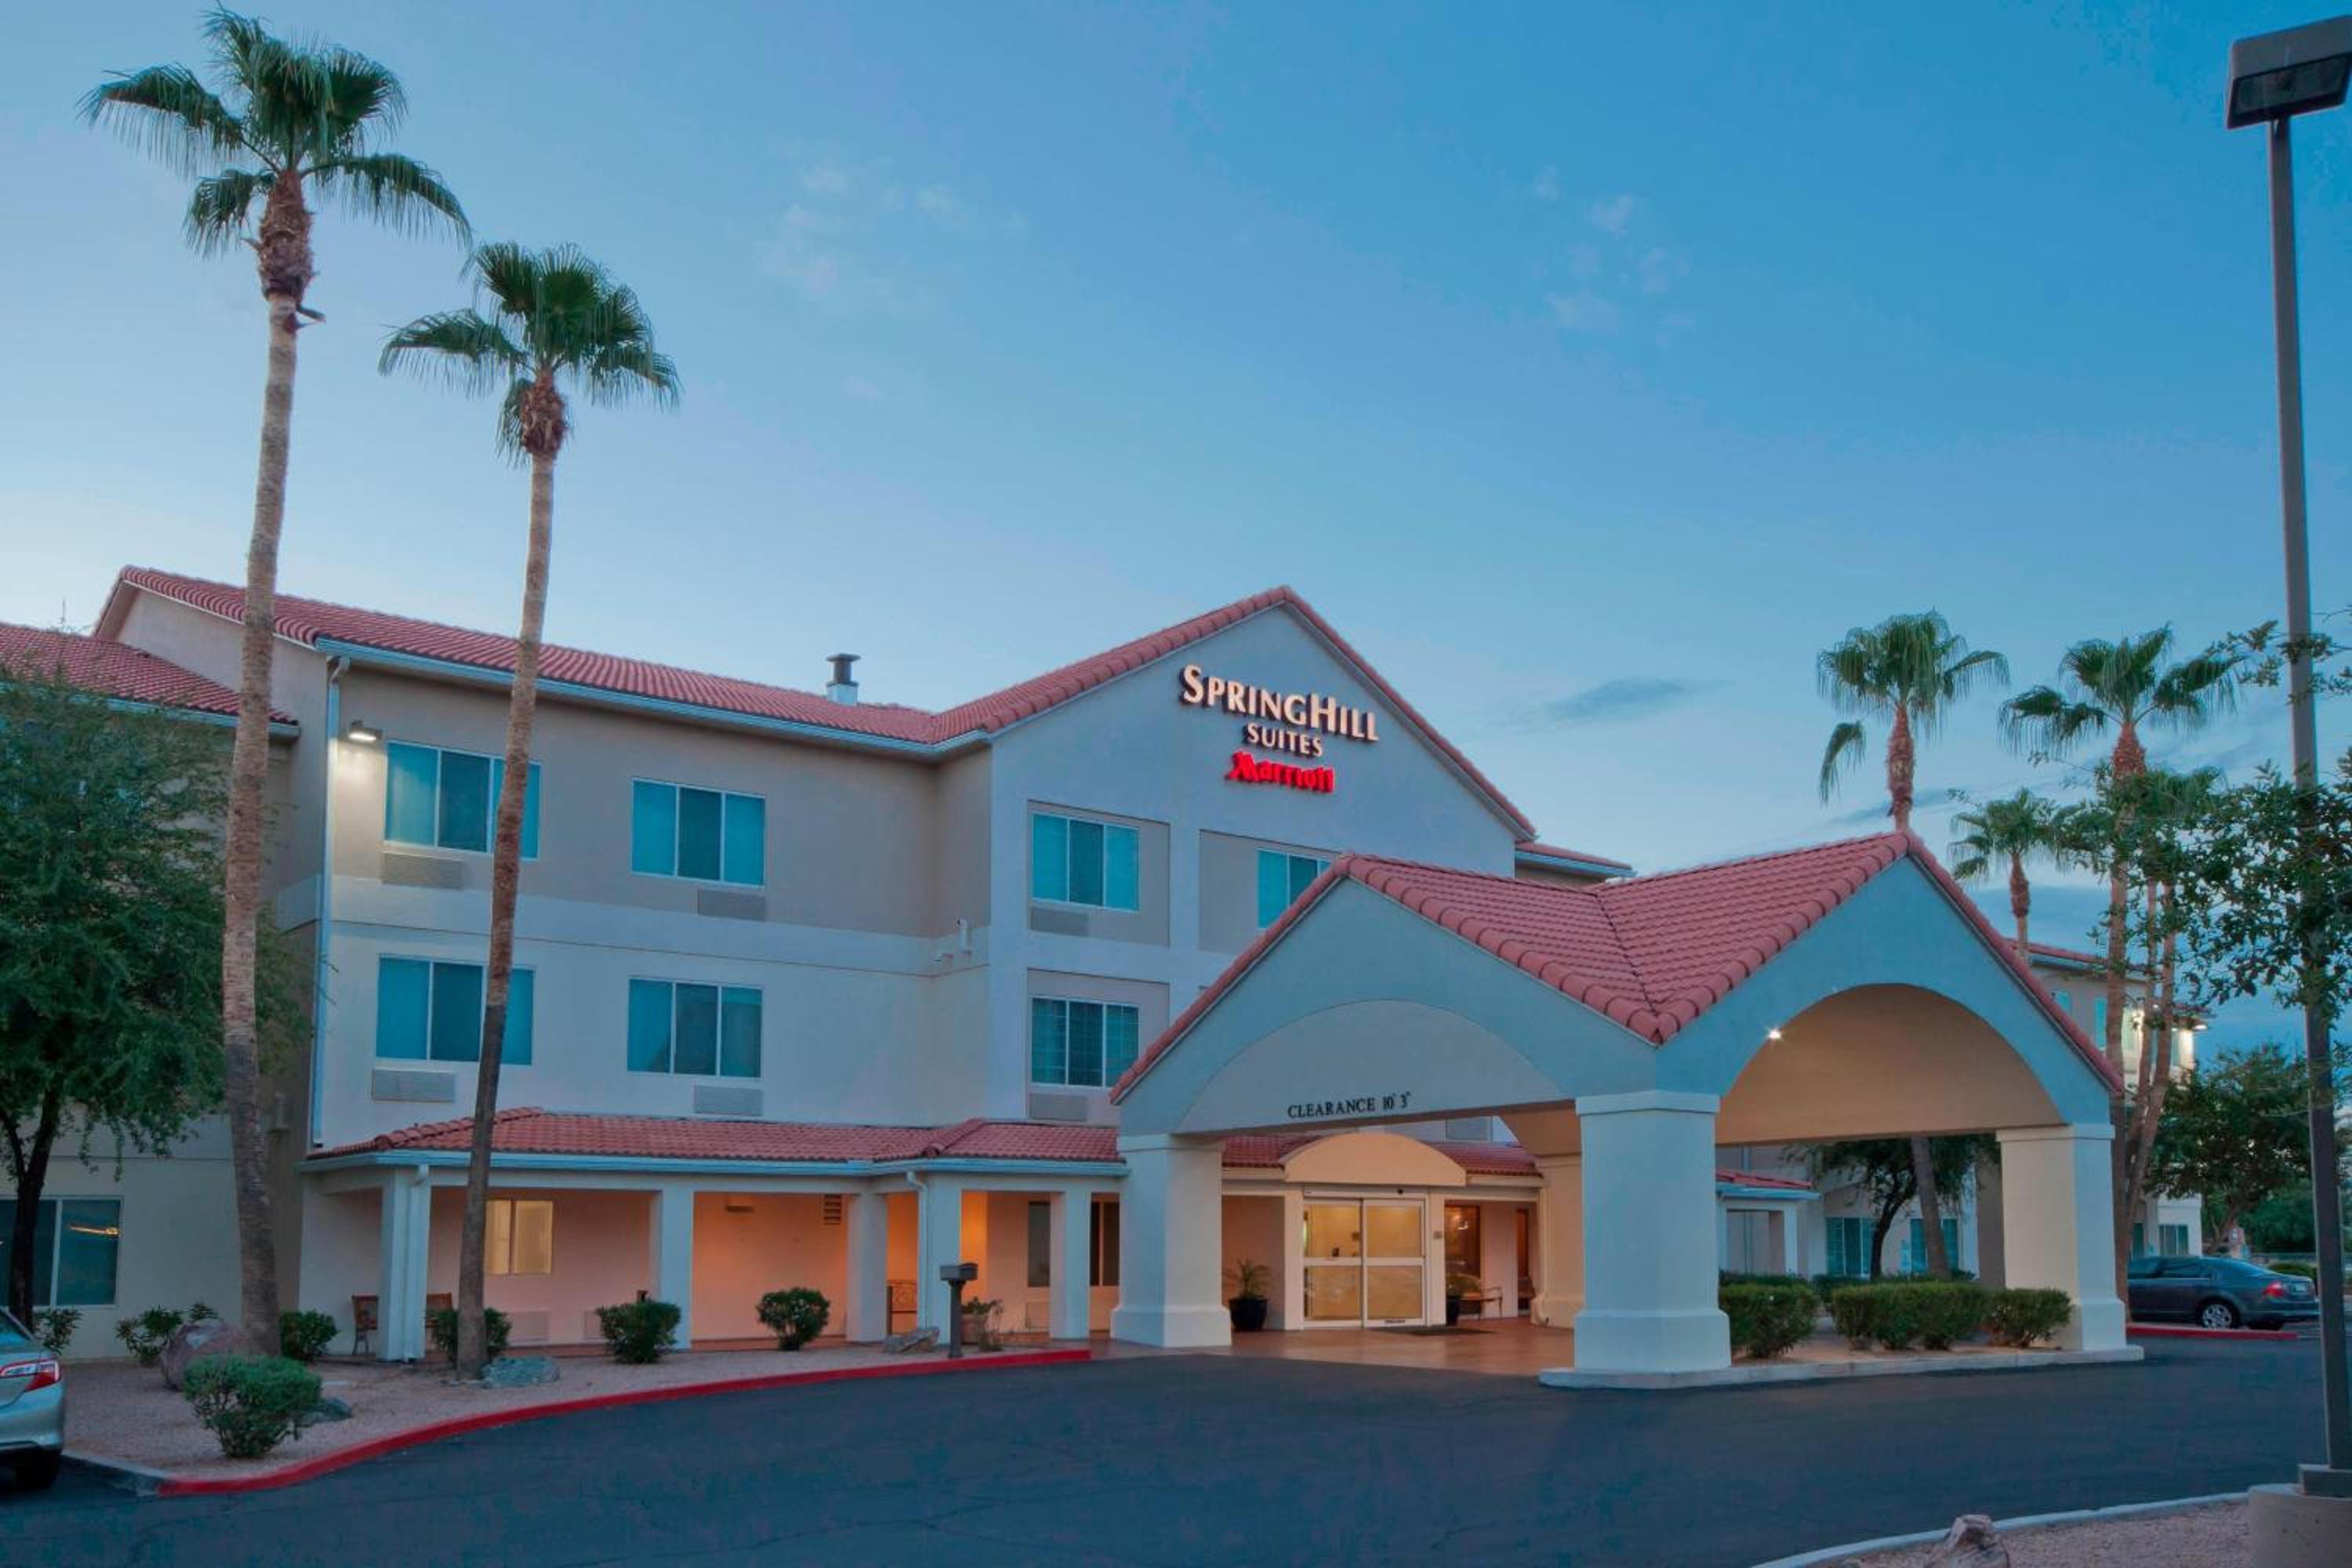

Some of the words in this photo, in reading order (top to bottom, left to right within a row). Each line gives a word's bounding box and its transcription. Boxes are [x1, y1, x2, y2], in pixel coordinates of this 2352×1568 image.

[1244, 722, 1323, 757] SUITES
[1226, 750, 1335, 793] Marriott
[1287, 1097, 1376, 1119] CLEARANCE
